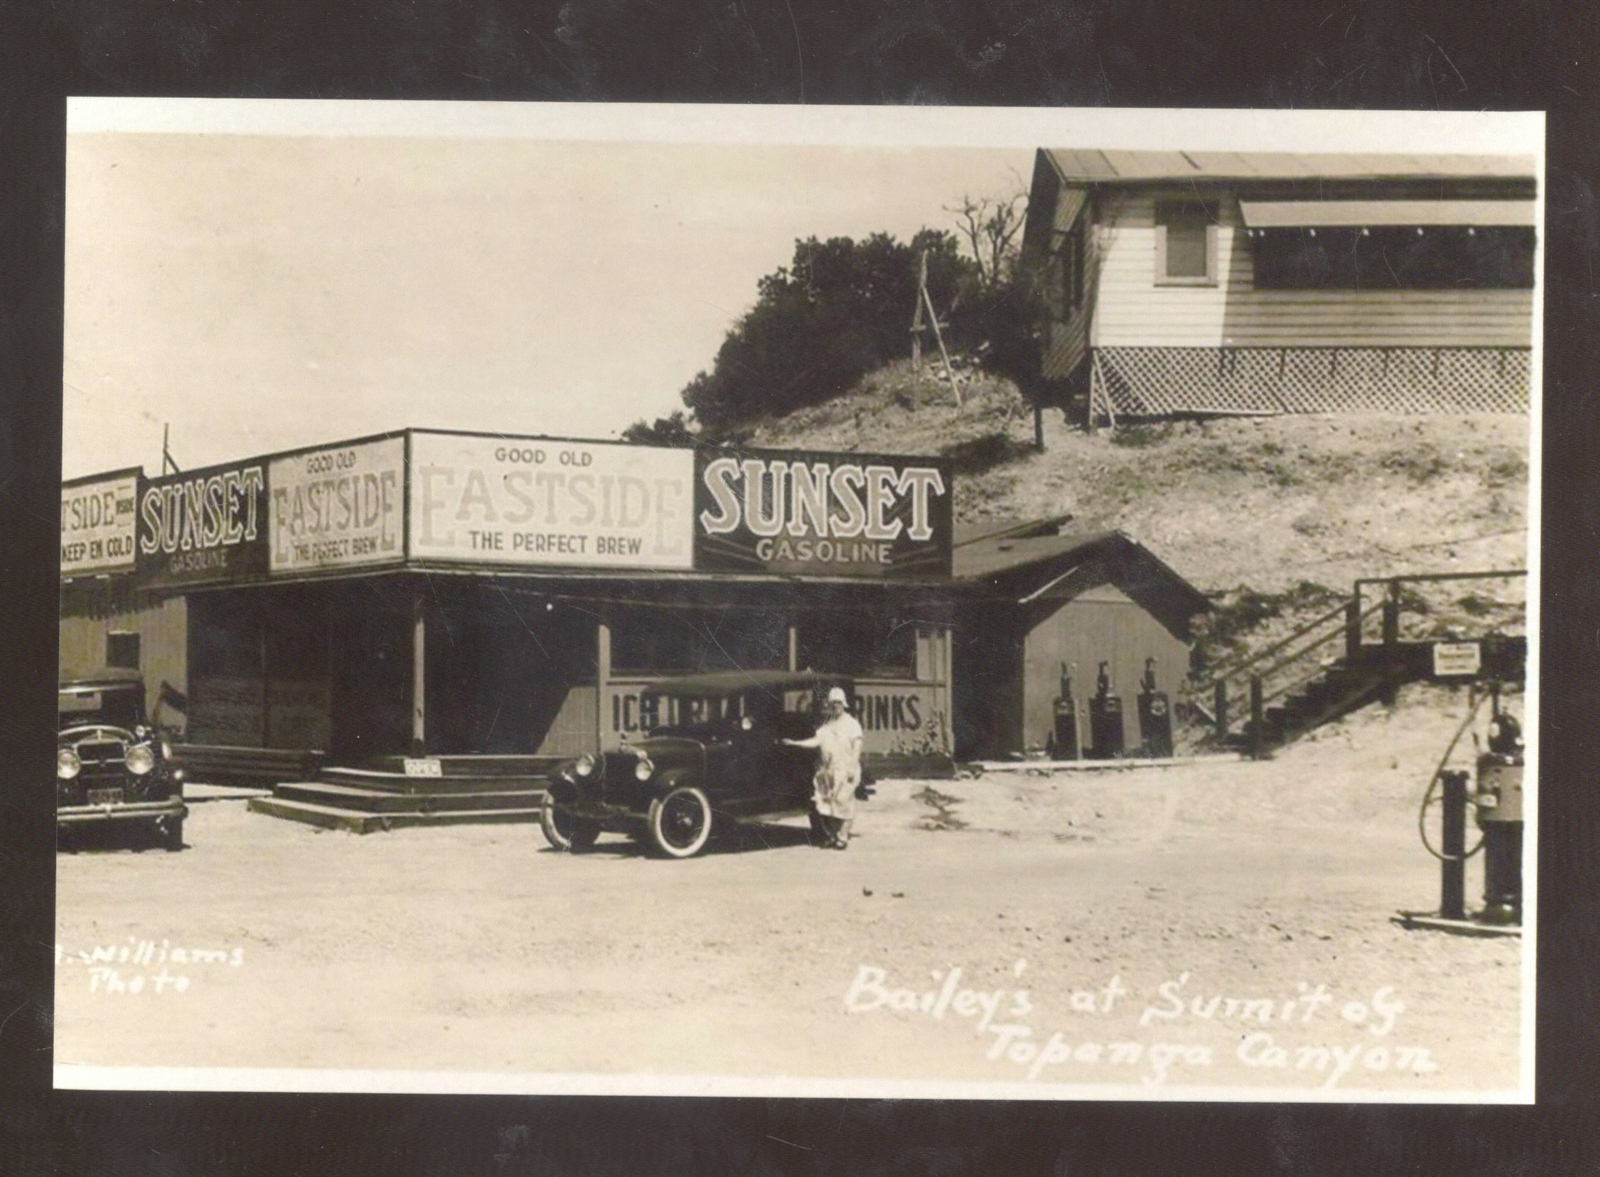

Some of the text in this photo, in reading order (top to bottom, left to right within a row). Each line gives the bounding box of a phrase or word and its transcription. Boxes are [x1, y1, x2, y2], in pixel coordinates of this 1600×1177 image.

[306, 451, 356, 474] GOOD OLD
[495, 447, 592, 466] GOOD OLD
[140, 466, 264, 554] SUNSET
[418, 465, 683, 556] EASTSIDE
[700, 457, 945, 541] SUNSET
[273, 470, 396, 563] EASTSIDE
[107, 535, 133, 557] COLD
[353, 536, 378, 555] BREW
[468, 530, 641, 555] THE PERFECT BREW
[756, 539, 893, 564] GASOLINE
[170, 548, 228, 574] GASOLINE
[853, 694, 921, 731] RINKS
